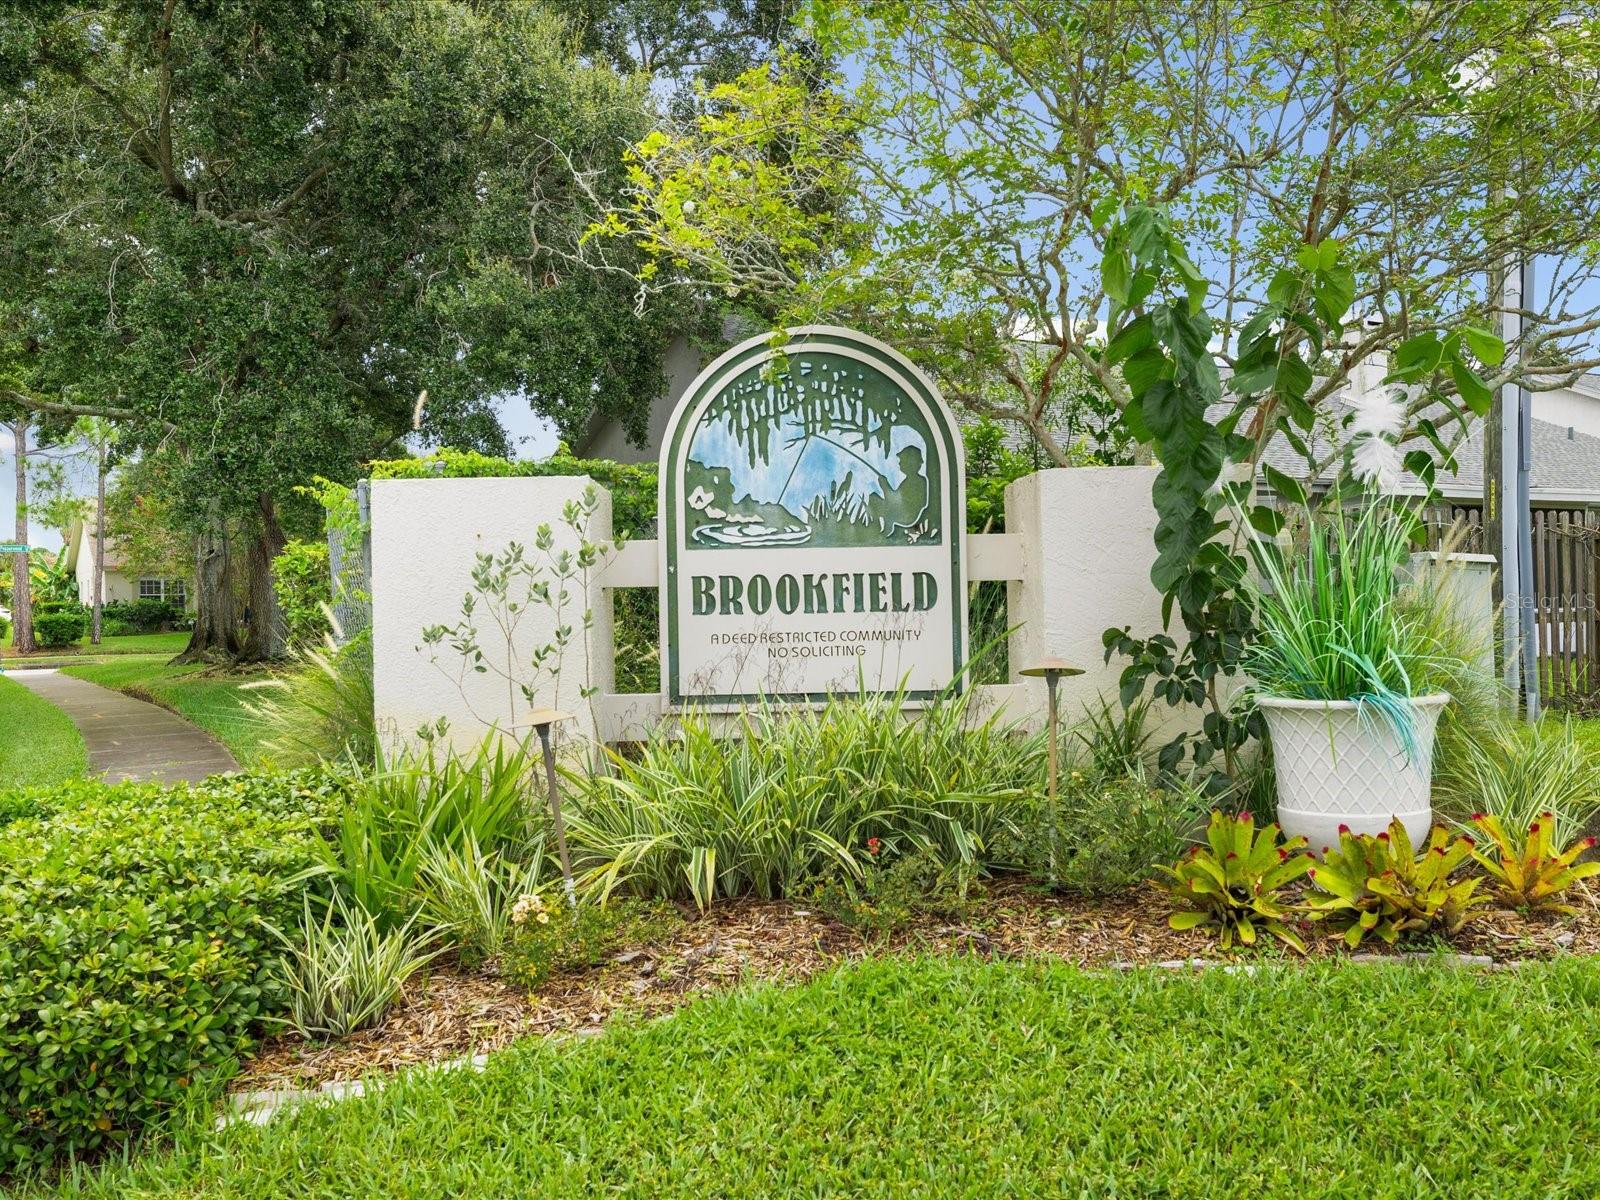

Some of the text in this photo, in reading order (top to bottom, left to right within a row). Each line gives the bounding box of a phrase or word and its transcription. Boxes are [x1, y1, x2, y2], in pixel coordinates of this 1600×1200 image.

[691, 572, 938, 616] BROOKFIELD
[722, 633, 757, 644] DEED
[761, 631, 836, 644] RESTRICTED
[840, 630, 922, 642] COMMUNITY
[768, 645, 867, 658] NO SOLICITING
